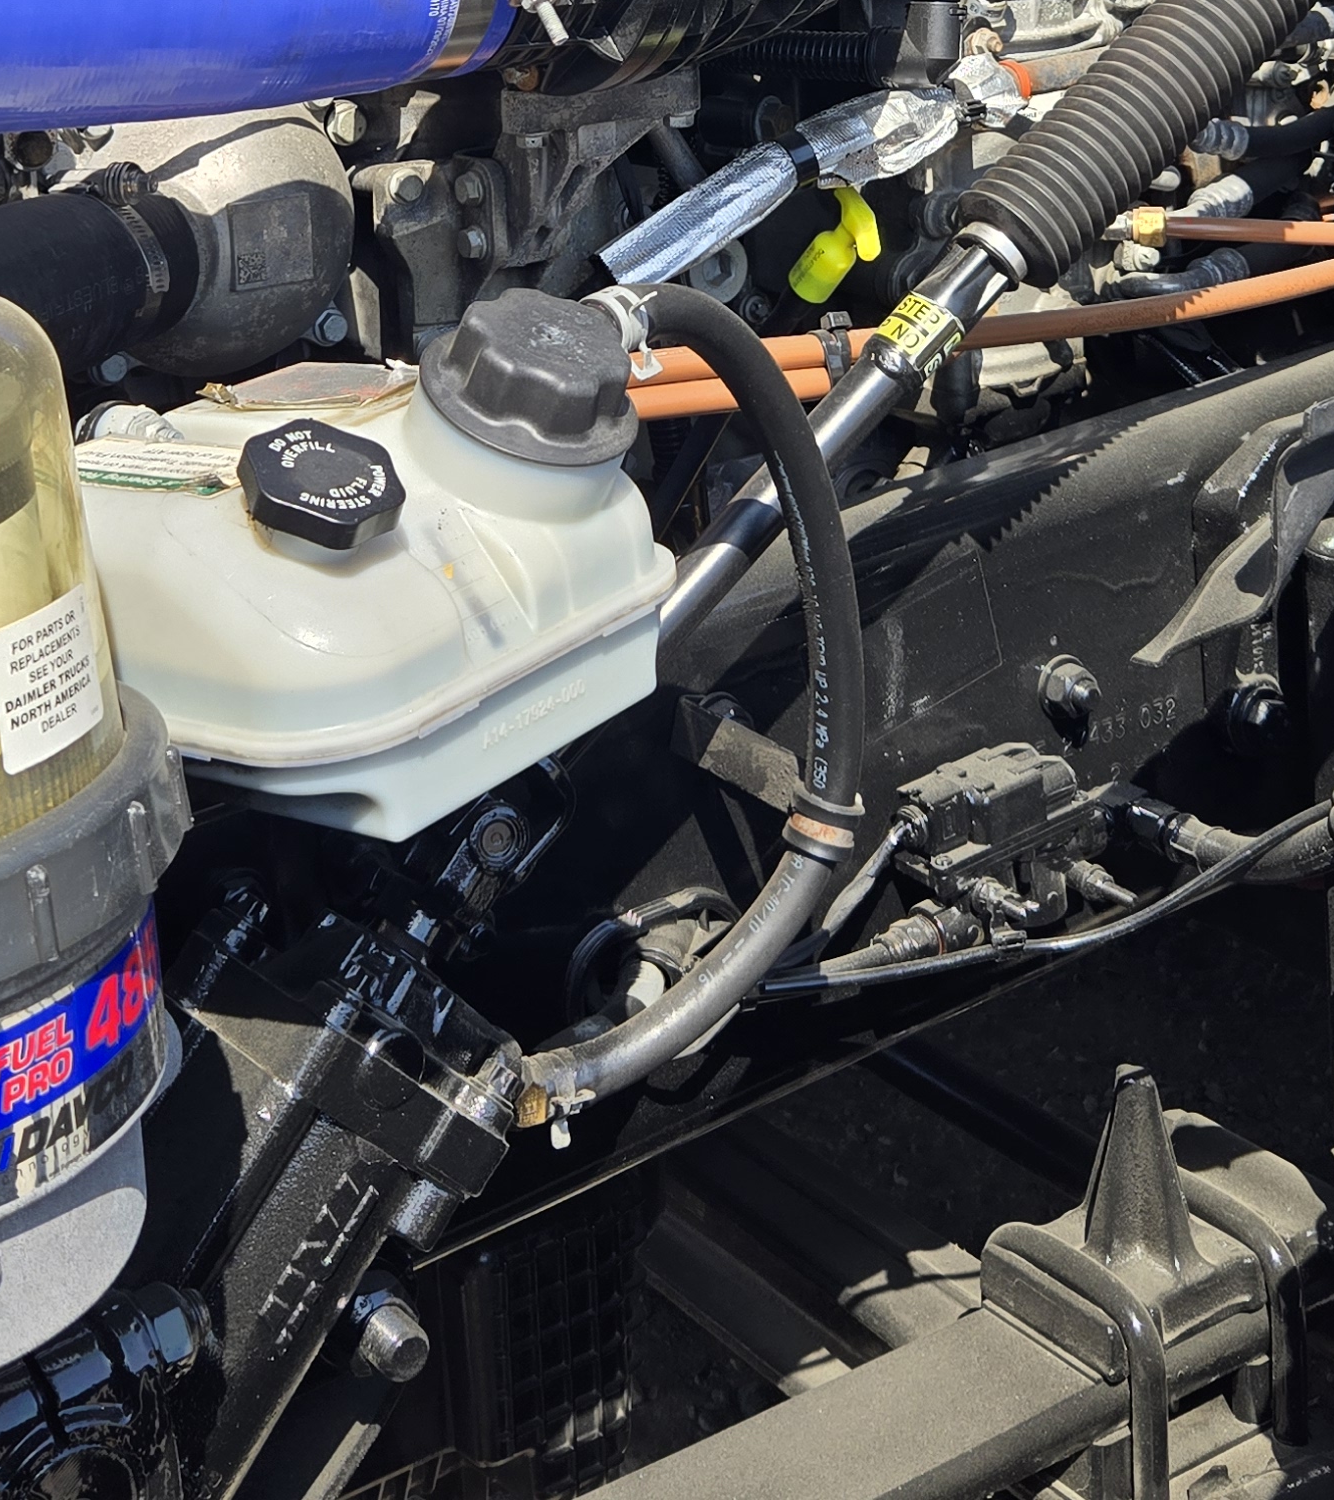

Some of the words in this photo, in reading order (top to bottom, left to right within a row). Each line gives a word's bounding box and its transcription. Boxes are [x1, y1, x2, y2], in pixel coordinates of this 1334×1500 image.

[898, 297, 940, 325] STEP
[890, 323, 919, 349] NO
[268, 438, 286, 452] DO
[285, 430, 312, 443] NOT
[281, 441, 336, 469] OVERFILL
[329, 476, 368, 498] FLUID
[368, 464, 387, 498] POWER
[299, 491, 372, 510] STEERING
[11, 636, 34, 655] FOR
[36, 618, 63, 644] PARTS
[64, 610, 76, 625] OR
[9, 625, 81, 675] REPLACEMENTS
[29, 666, 49, 684] SEE
[50, 649, 74, 673] YOUR
[4, 679, 57, 713] DAIMLER
[59, 655, 90, 685] TRUCKS
[10, 702, 52, 731] NORTH
[54, 675, 91, 708] AMERICA
[41, 703, 78, 733] DEALER
[814, 691, 829, 717] 2.4
[1139, 695, 1177, 729] 032
[814, 720, 829, 749] MPa
[813, 753, 829, 789] (350
[0, 1046, 74, 1115] PRO
[16, 1050, 135, 1167] DAVCO
